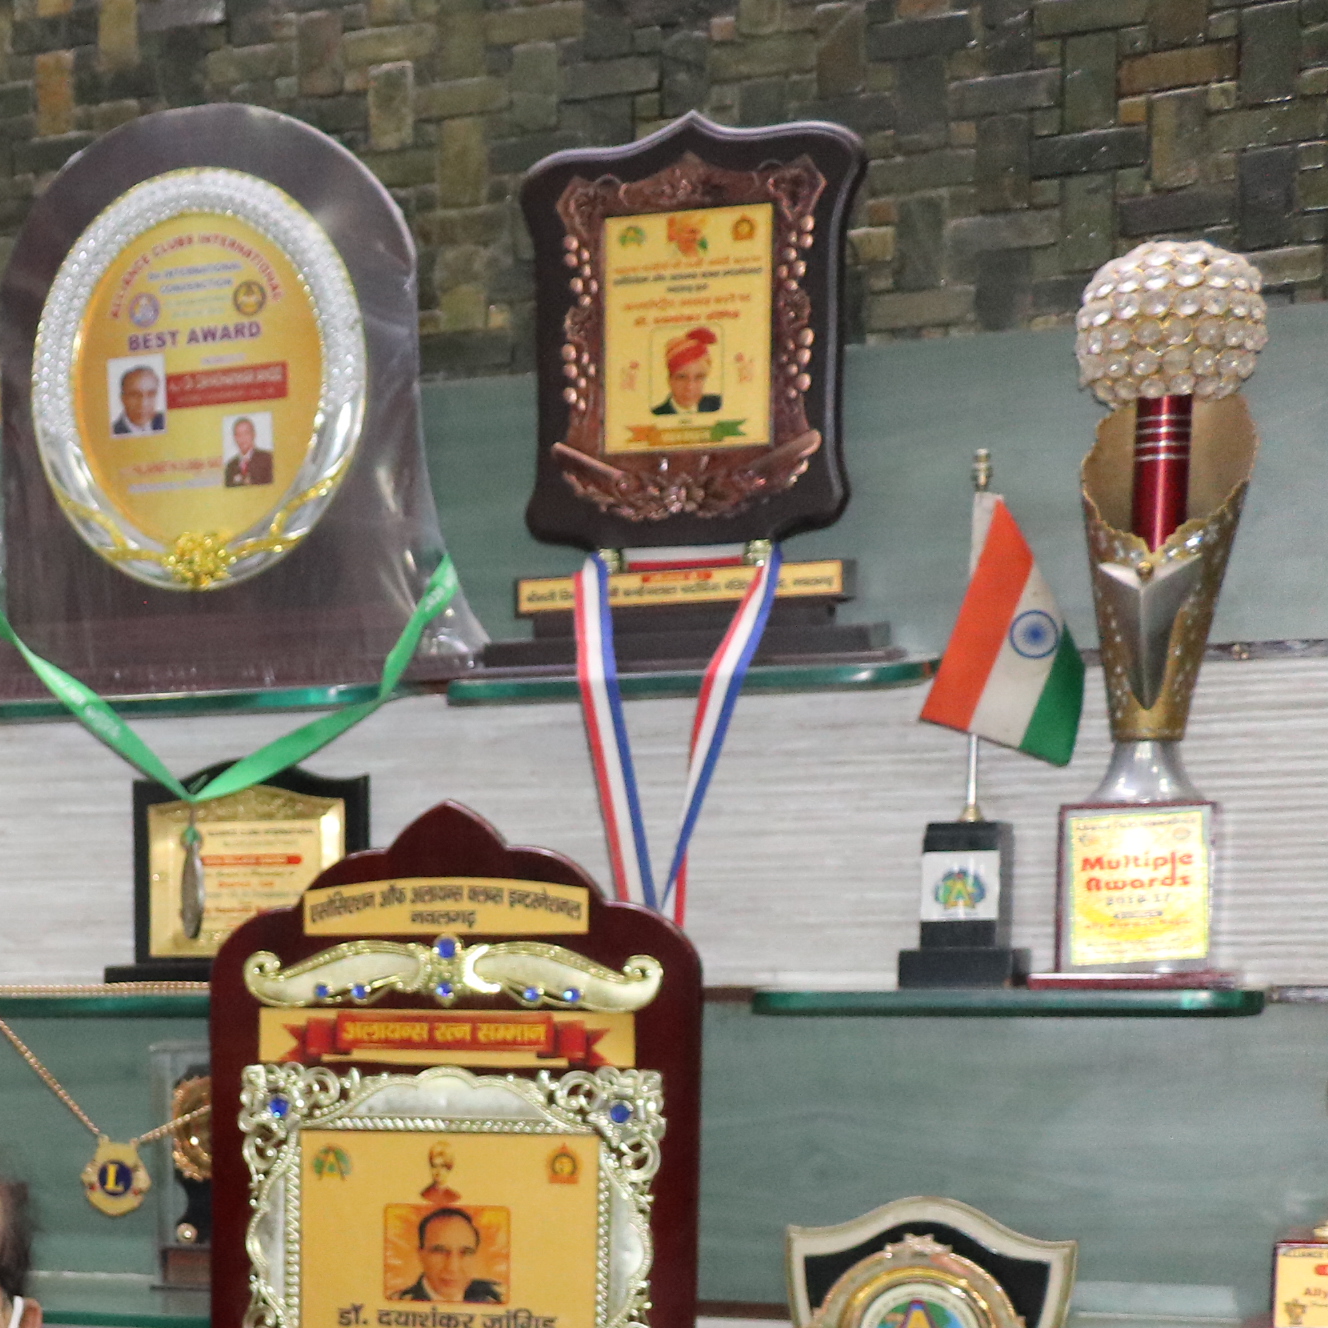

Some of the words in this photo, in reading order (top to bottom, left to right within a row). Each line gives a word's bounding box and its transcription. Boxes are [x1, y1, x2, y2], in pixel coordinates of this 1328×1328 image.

[128, 330, 179, 352] BEST
[187, 321, 262, 345] AWARD
[1081, 852, 1194, 872] Multiple
[1086, 875, 1192, 891] Awards
[344, 1021, 430, 1042] अलायन्स
[434, 1021, 472, 1042] रत्न
[477, 1021, 547, 1042] सम्मान
[337, 1303, 368, 1328] डॉ.
